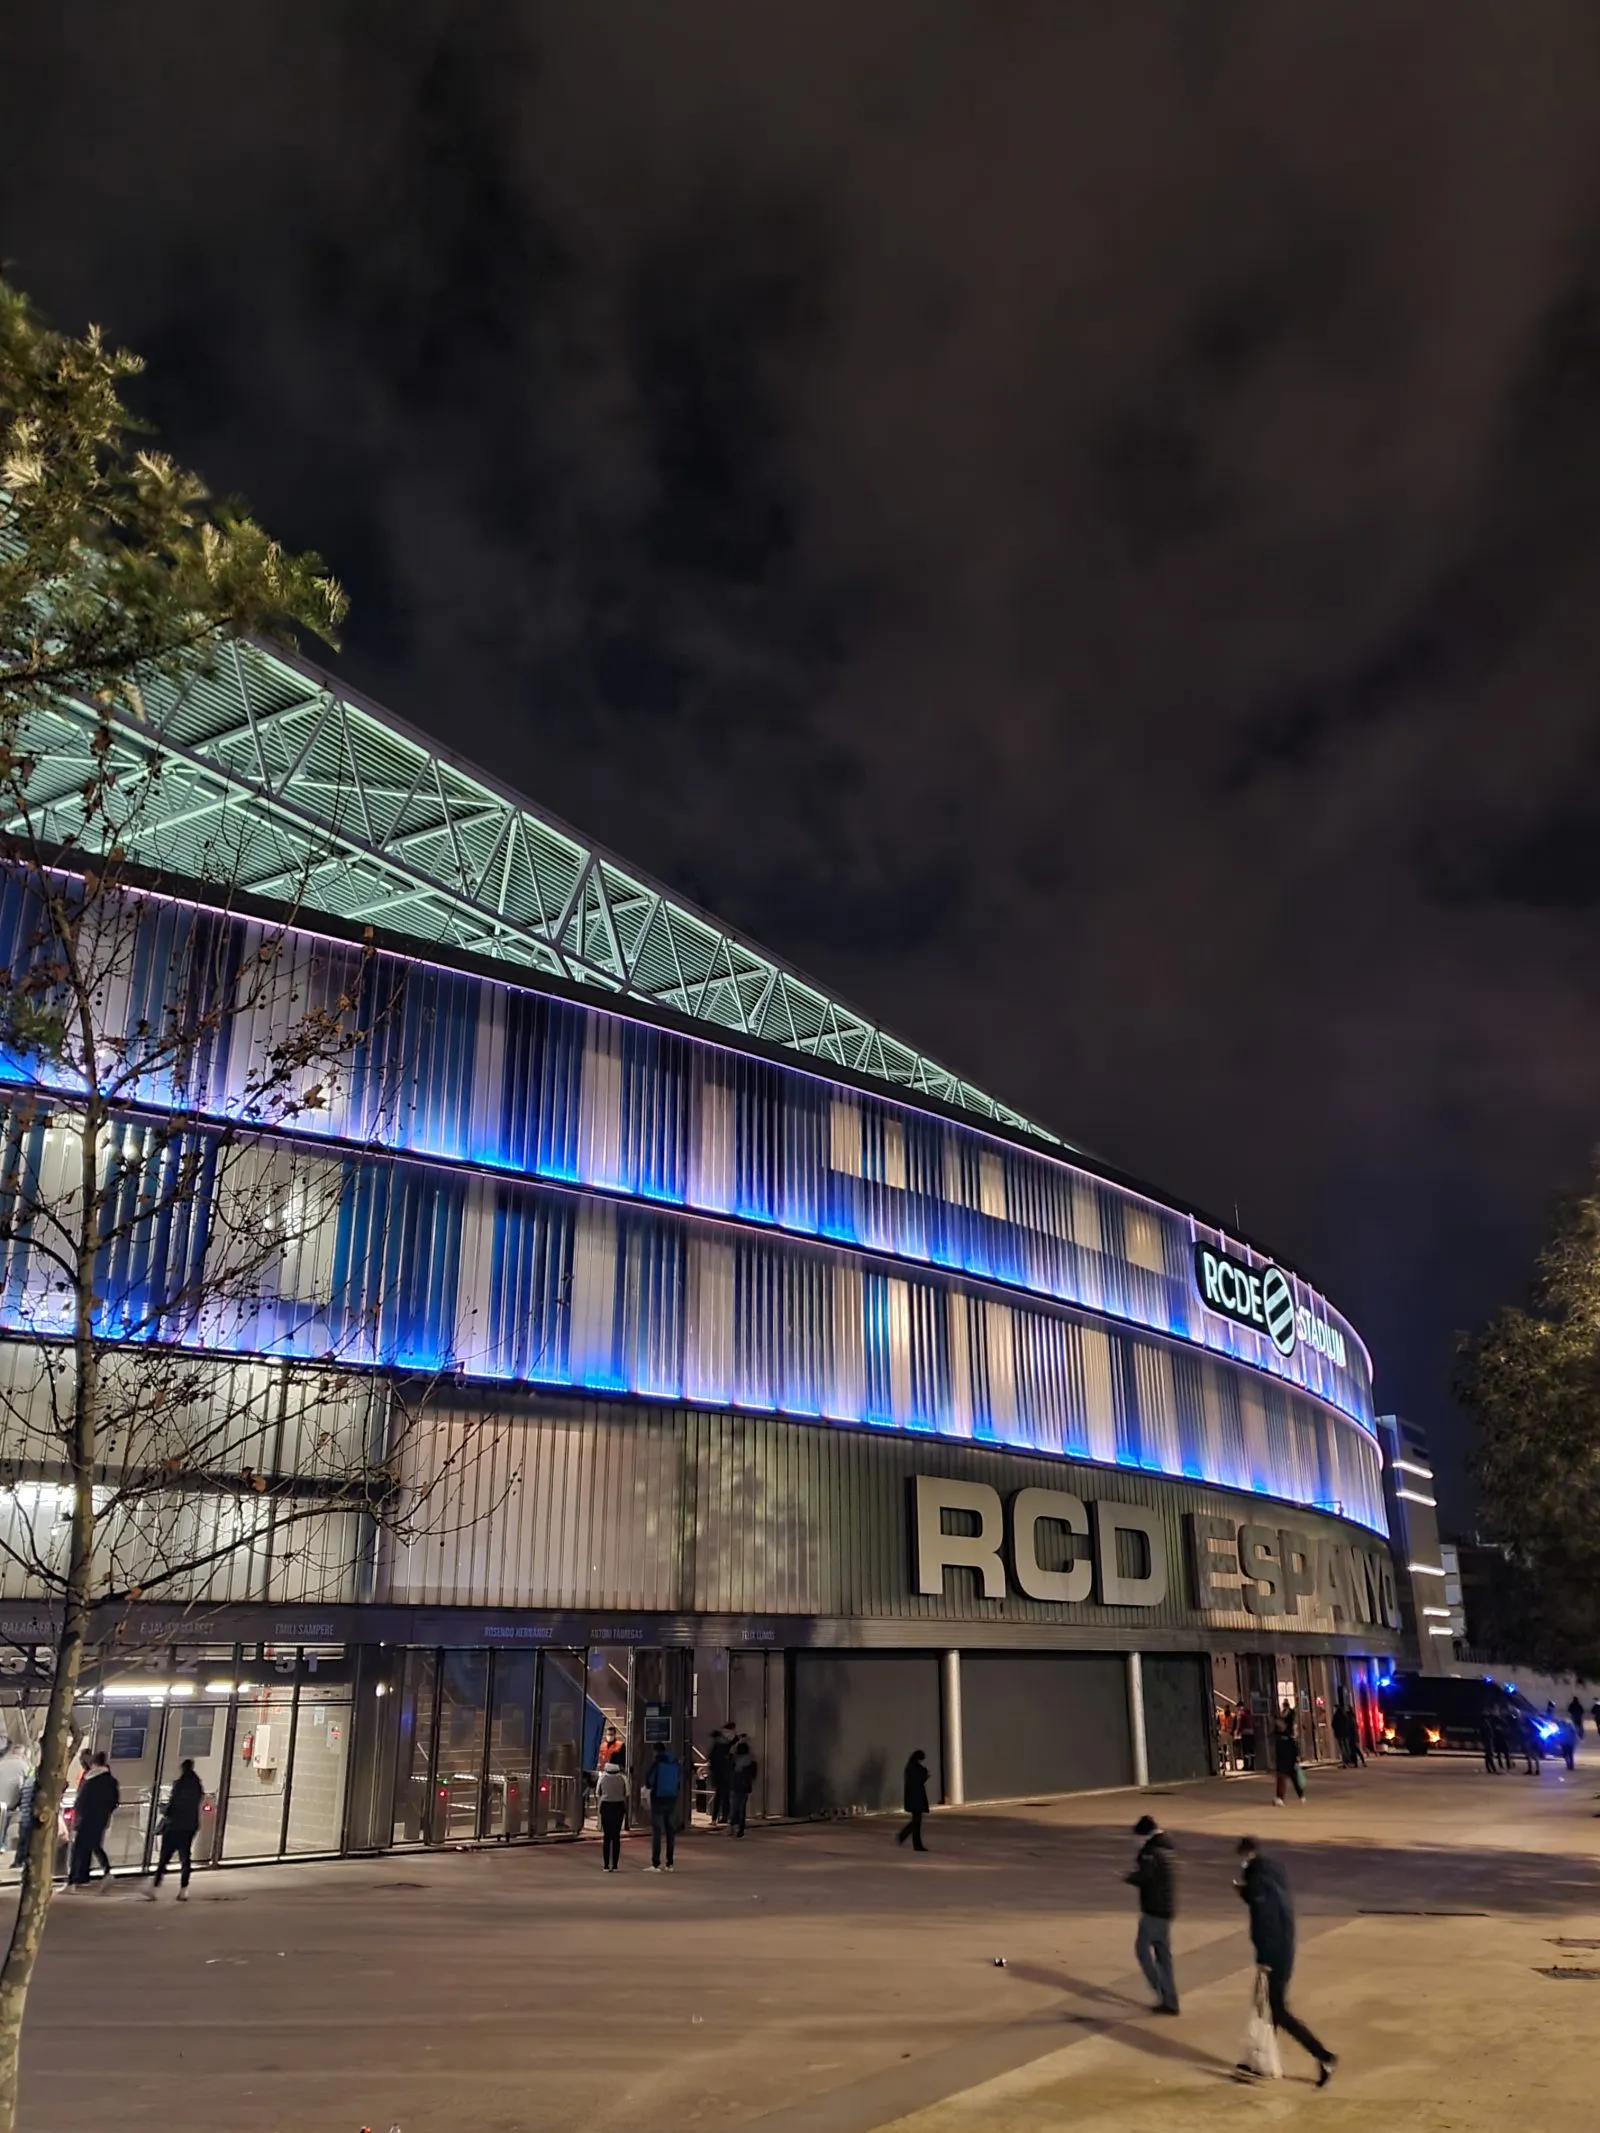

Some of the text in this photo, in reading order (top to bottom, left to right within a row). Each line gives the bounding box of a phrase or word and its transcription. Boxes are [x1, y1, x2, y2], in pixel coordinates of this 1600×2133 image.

[1202, 1251, 1265, 1324] RCDE
[1295, 1305, 1347, 1367] STADIUM
[914, 1474, 1168, 1607] RCD
[298, 1623, 335, 1635] SAMPERE
[275, 1651, 318, 1673] 51
